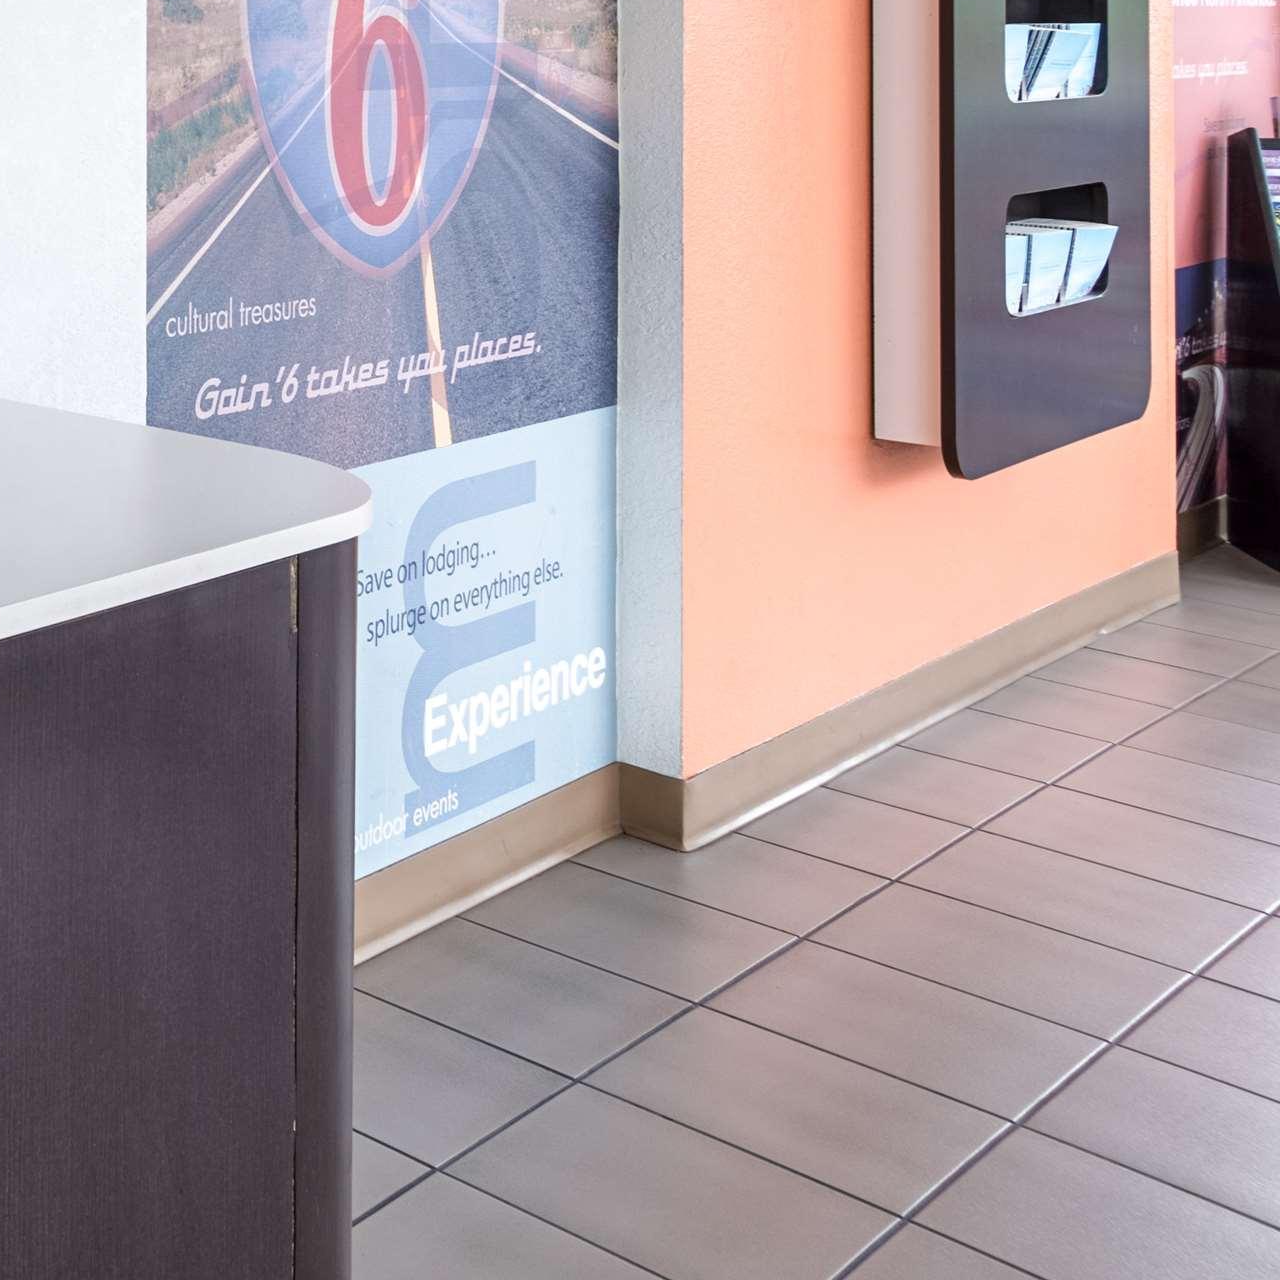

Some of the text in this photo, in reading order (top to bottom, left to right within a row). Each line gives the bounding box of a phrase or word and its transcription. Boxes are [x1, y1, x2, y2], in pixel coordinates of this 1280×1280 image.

[166, 297, 317, 337] cultural treasures
[306, 356, 389, 398] takes
[397, 350, 447, 393] you
[451, 332, 542, 384] places.
[356, 540, 496, 597] Save on lodging...
[366, 558, 564, 646] splurge on everything else.
[424, 646, 607, 757] Experience
[413, 789, 459, 827] events
